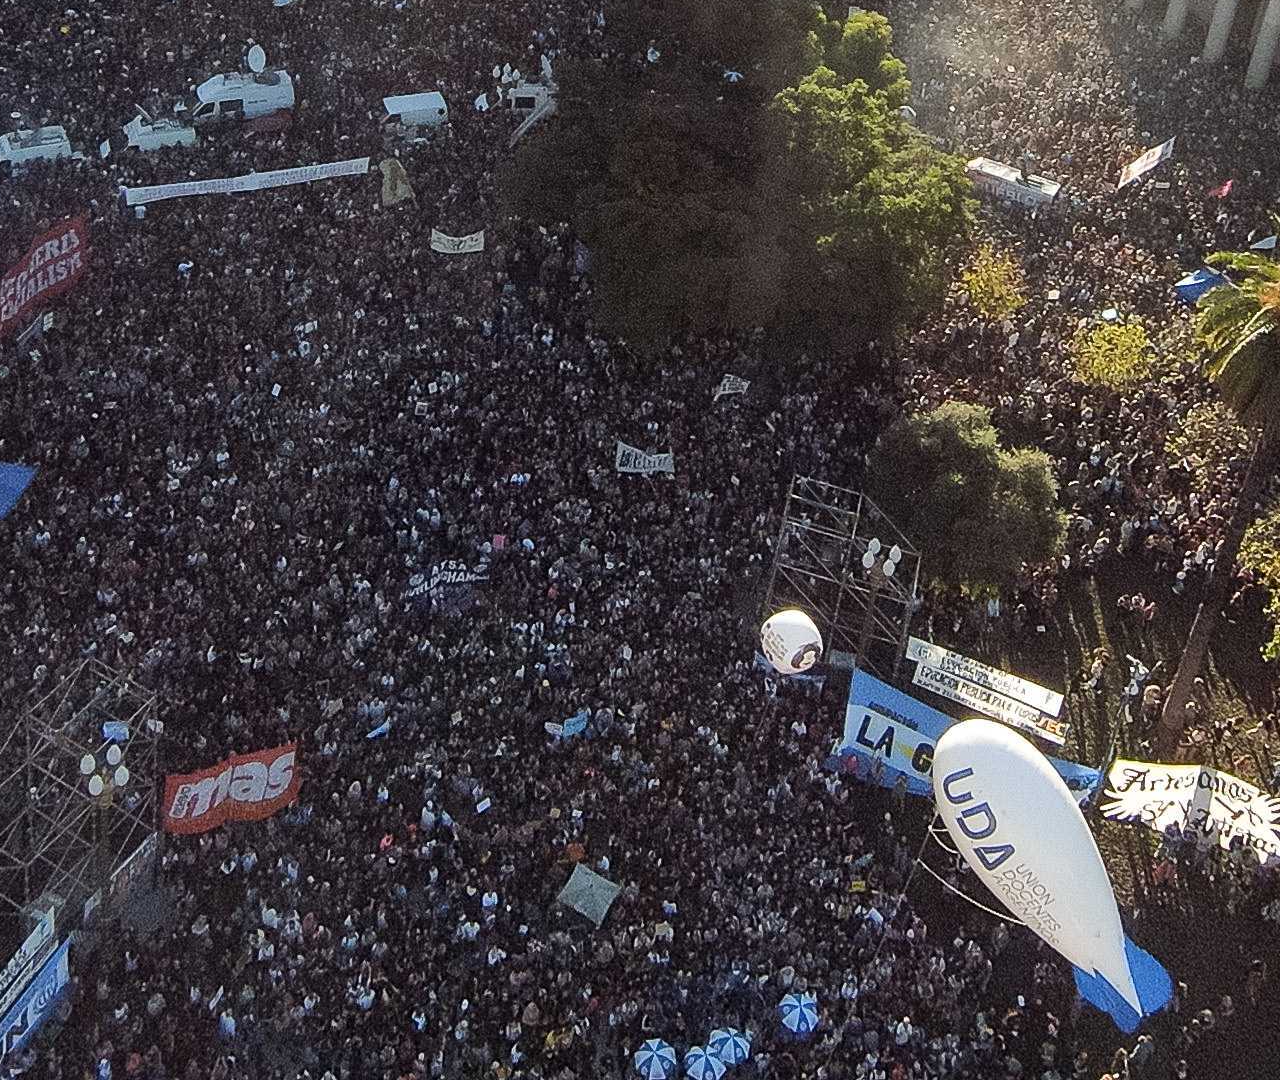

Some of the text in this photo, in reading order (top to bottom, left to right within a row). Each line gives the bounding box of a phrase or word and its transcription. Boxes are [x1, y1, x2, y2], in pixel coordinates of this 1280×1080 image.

[855, 714, 895, 759] LA
[169, 751, 296, 819] mas
[942, 767, 1016, 871] UDA
[1002, 869, 1062, 932] DOCENTES
